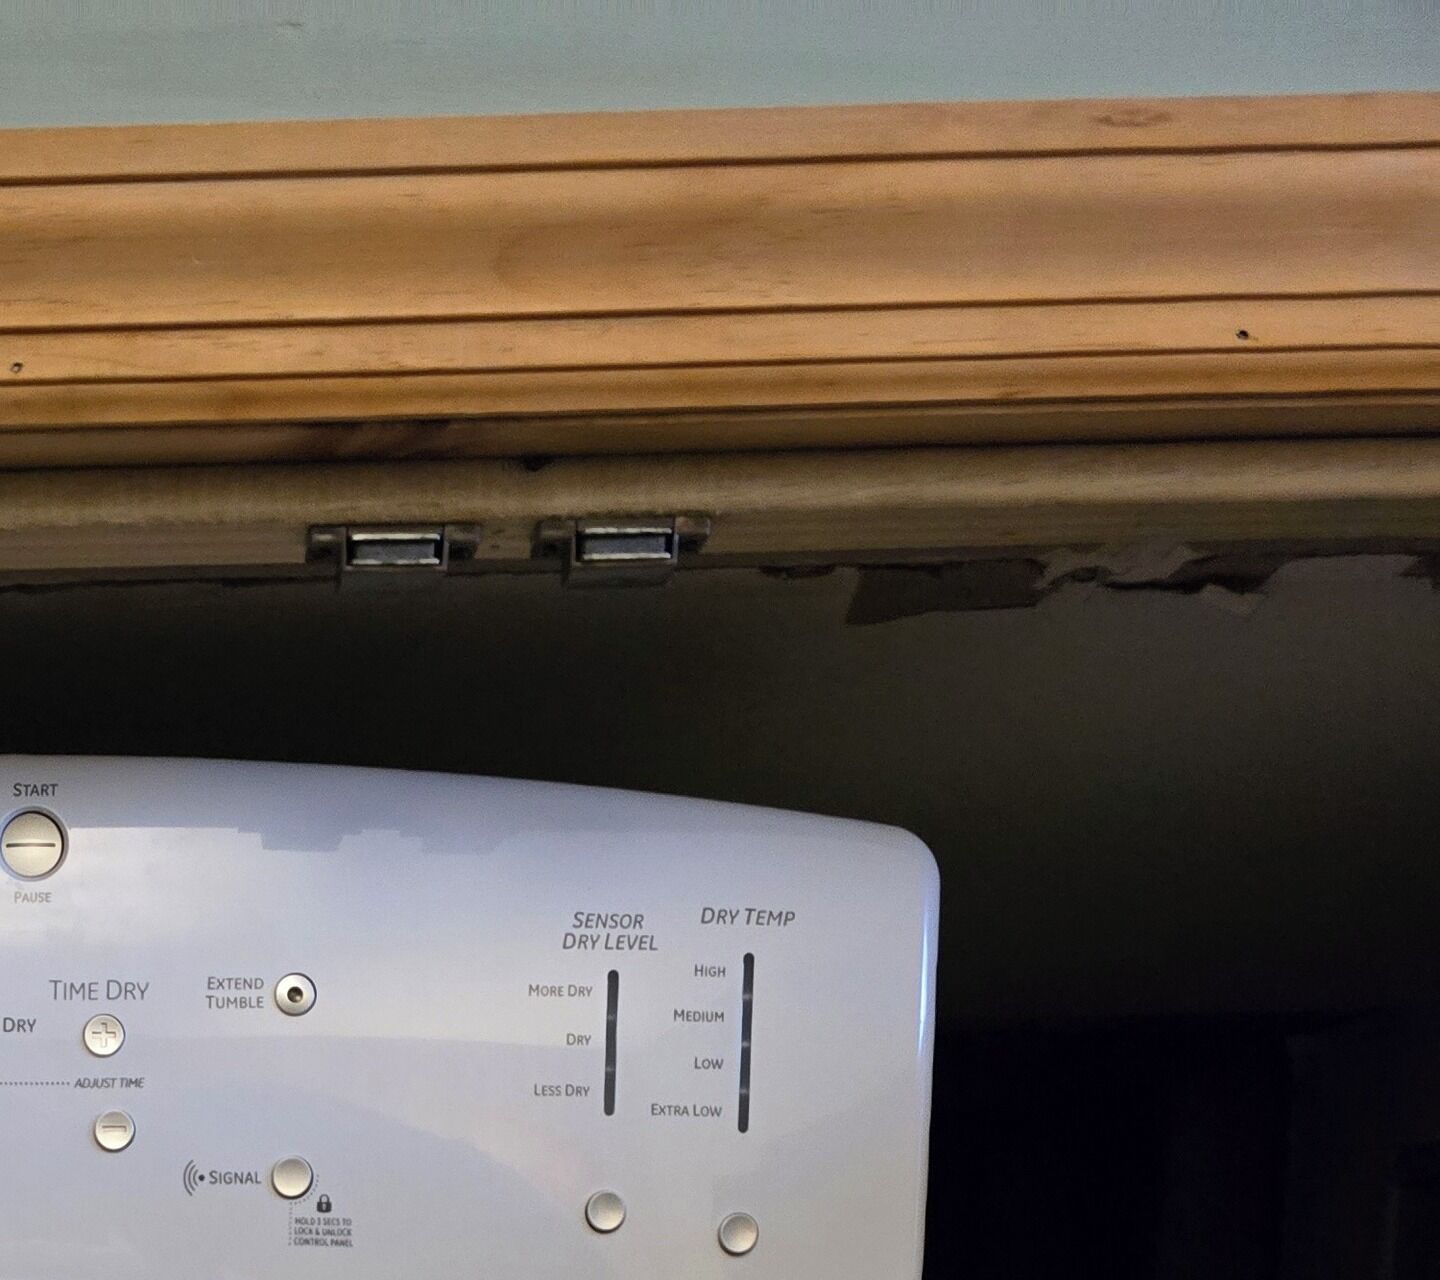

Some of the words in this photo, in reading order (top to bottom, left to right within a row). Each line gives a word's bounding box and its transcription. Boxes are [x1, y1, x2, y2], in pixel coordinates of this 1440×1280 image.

[12, 782, 59, 799] START
[13, 891, 52, 904] PAUSE
[572, 911, 645, 930] SENSOR
[700, 907, 740, 926] DRY
[744, 908, 796, 928] TEMP
[562, 932, 601, 951] DRY
[604, 933, 659, 952] LEVEL
[693, 964, 727, 979] HIGH
[48, 978, 100, 1001] TIME
[105, 979, 151, 1001] DRY
[206, 976, 265, 992] EXTEND
[527, 983, 565, 998] MORE
[567, 984, 594, 998] DRY
[205, 995, 265, 1010] TUMBLE
[673, 1008, 725, 1023] MEDIUM
[2, 1016, 37, 1034] DRY
[565, 1033, 592, 1047] DRY
[693, 1057, 725, 1071] LOW
[73, 1076, 116, 1090] ADJUST
[118, 1076, 146, 1090] TIME
[533, 1083, 562, 1097] LESS
[564, 1083, 591, 1098] DRY
[650, 1103, 690, 1117] EXTRA
[692, 1104, 723, 1118] LOW
[208, 1169, 262, 1186] SIGNAL
[294, 1217, 316, 1226] HOLD
[322, 1217, 341, 1227] SECS
[342, 1217, 352, 1227] TO
[294, 1226, 313, 1236] LOCK
[322, 1228, 353, 1237] UNLOCK
[294, 1237, 329, 1248] CONTROL
[330, 1238, 354, 1248] PANEL
